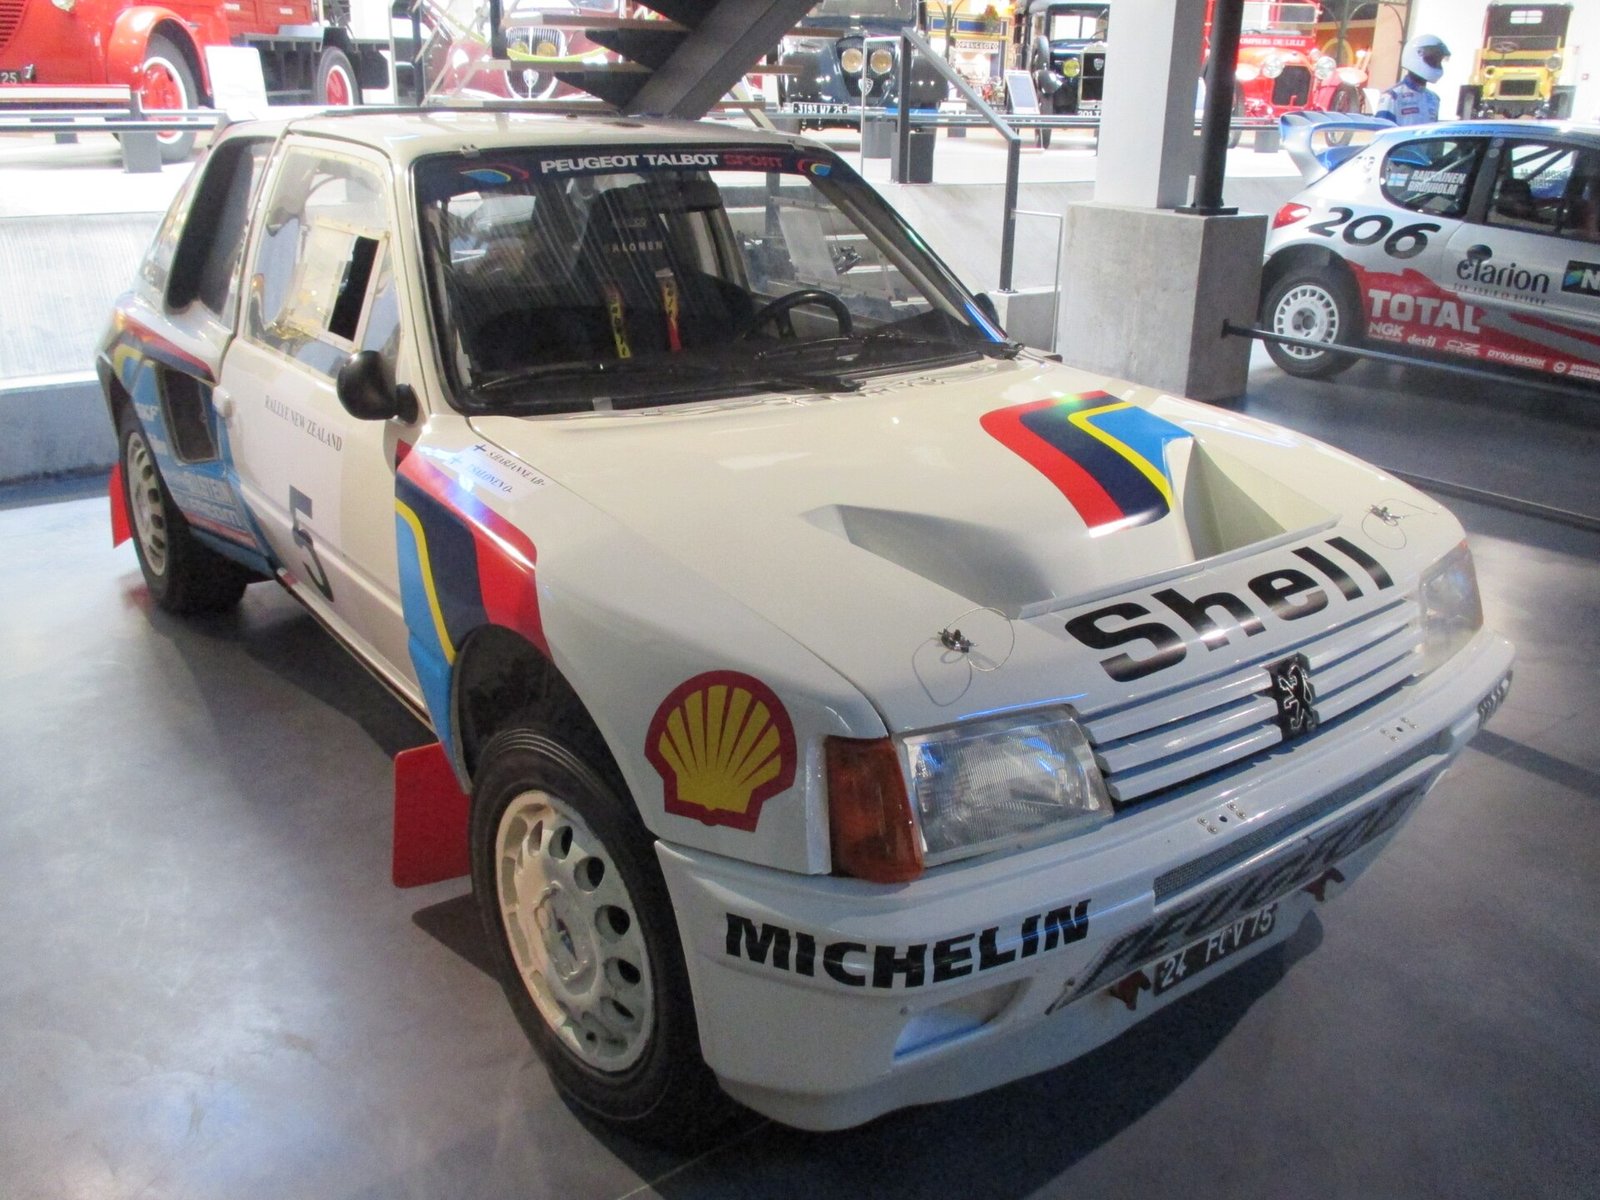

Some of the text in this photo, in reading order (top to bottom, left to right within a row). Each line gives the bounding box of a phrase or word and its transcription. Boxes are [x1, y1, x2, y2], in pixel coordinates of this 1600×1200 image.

[541, 153, 784, 174] PEUGEOT TALBOT SPORT
[1305, 206, 1442, 260] 206
[1368, 289, 1480, 335] TOTAL
[1368, 321, 1405, 338] NGK
[291, 410, 305, 428] NEW
[307, 419, 342, 451] ZEALAND
[289, 485, 335, 603] 5
[1064, 536, 1394, 683] Shell
[726, 899, 1092, 988] MICHELIN
